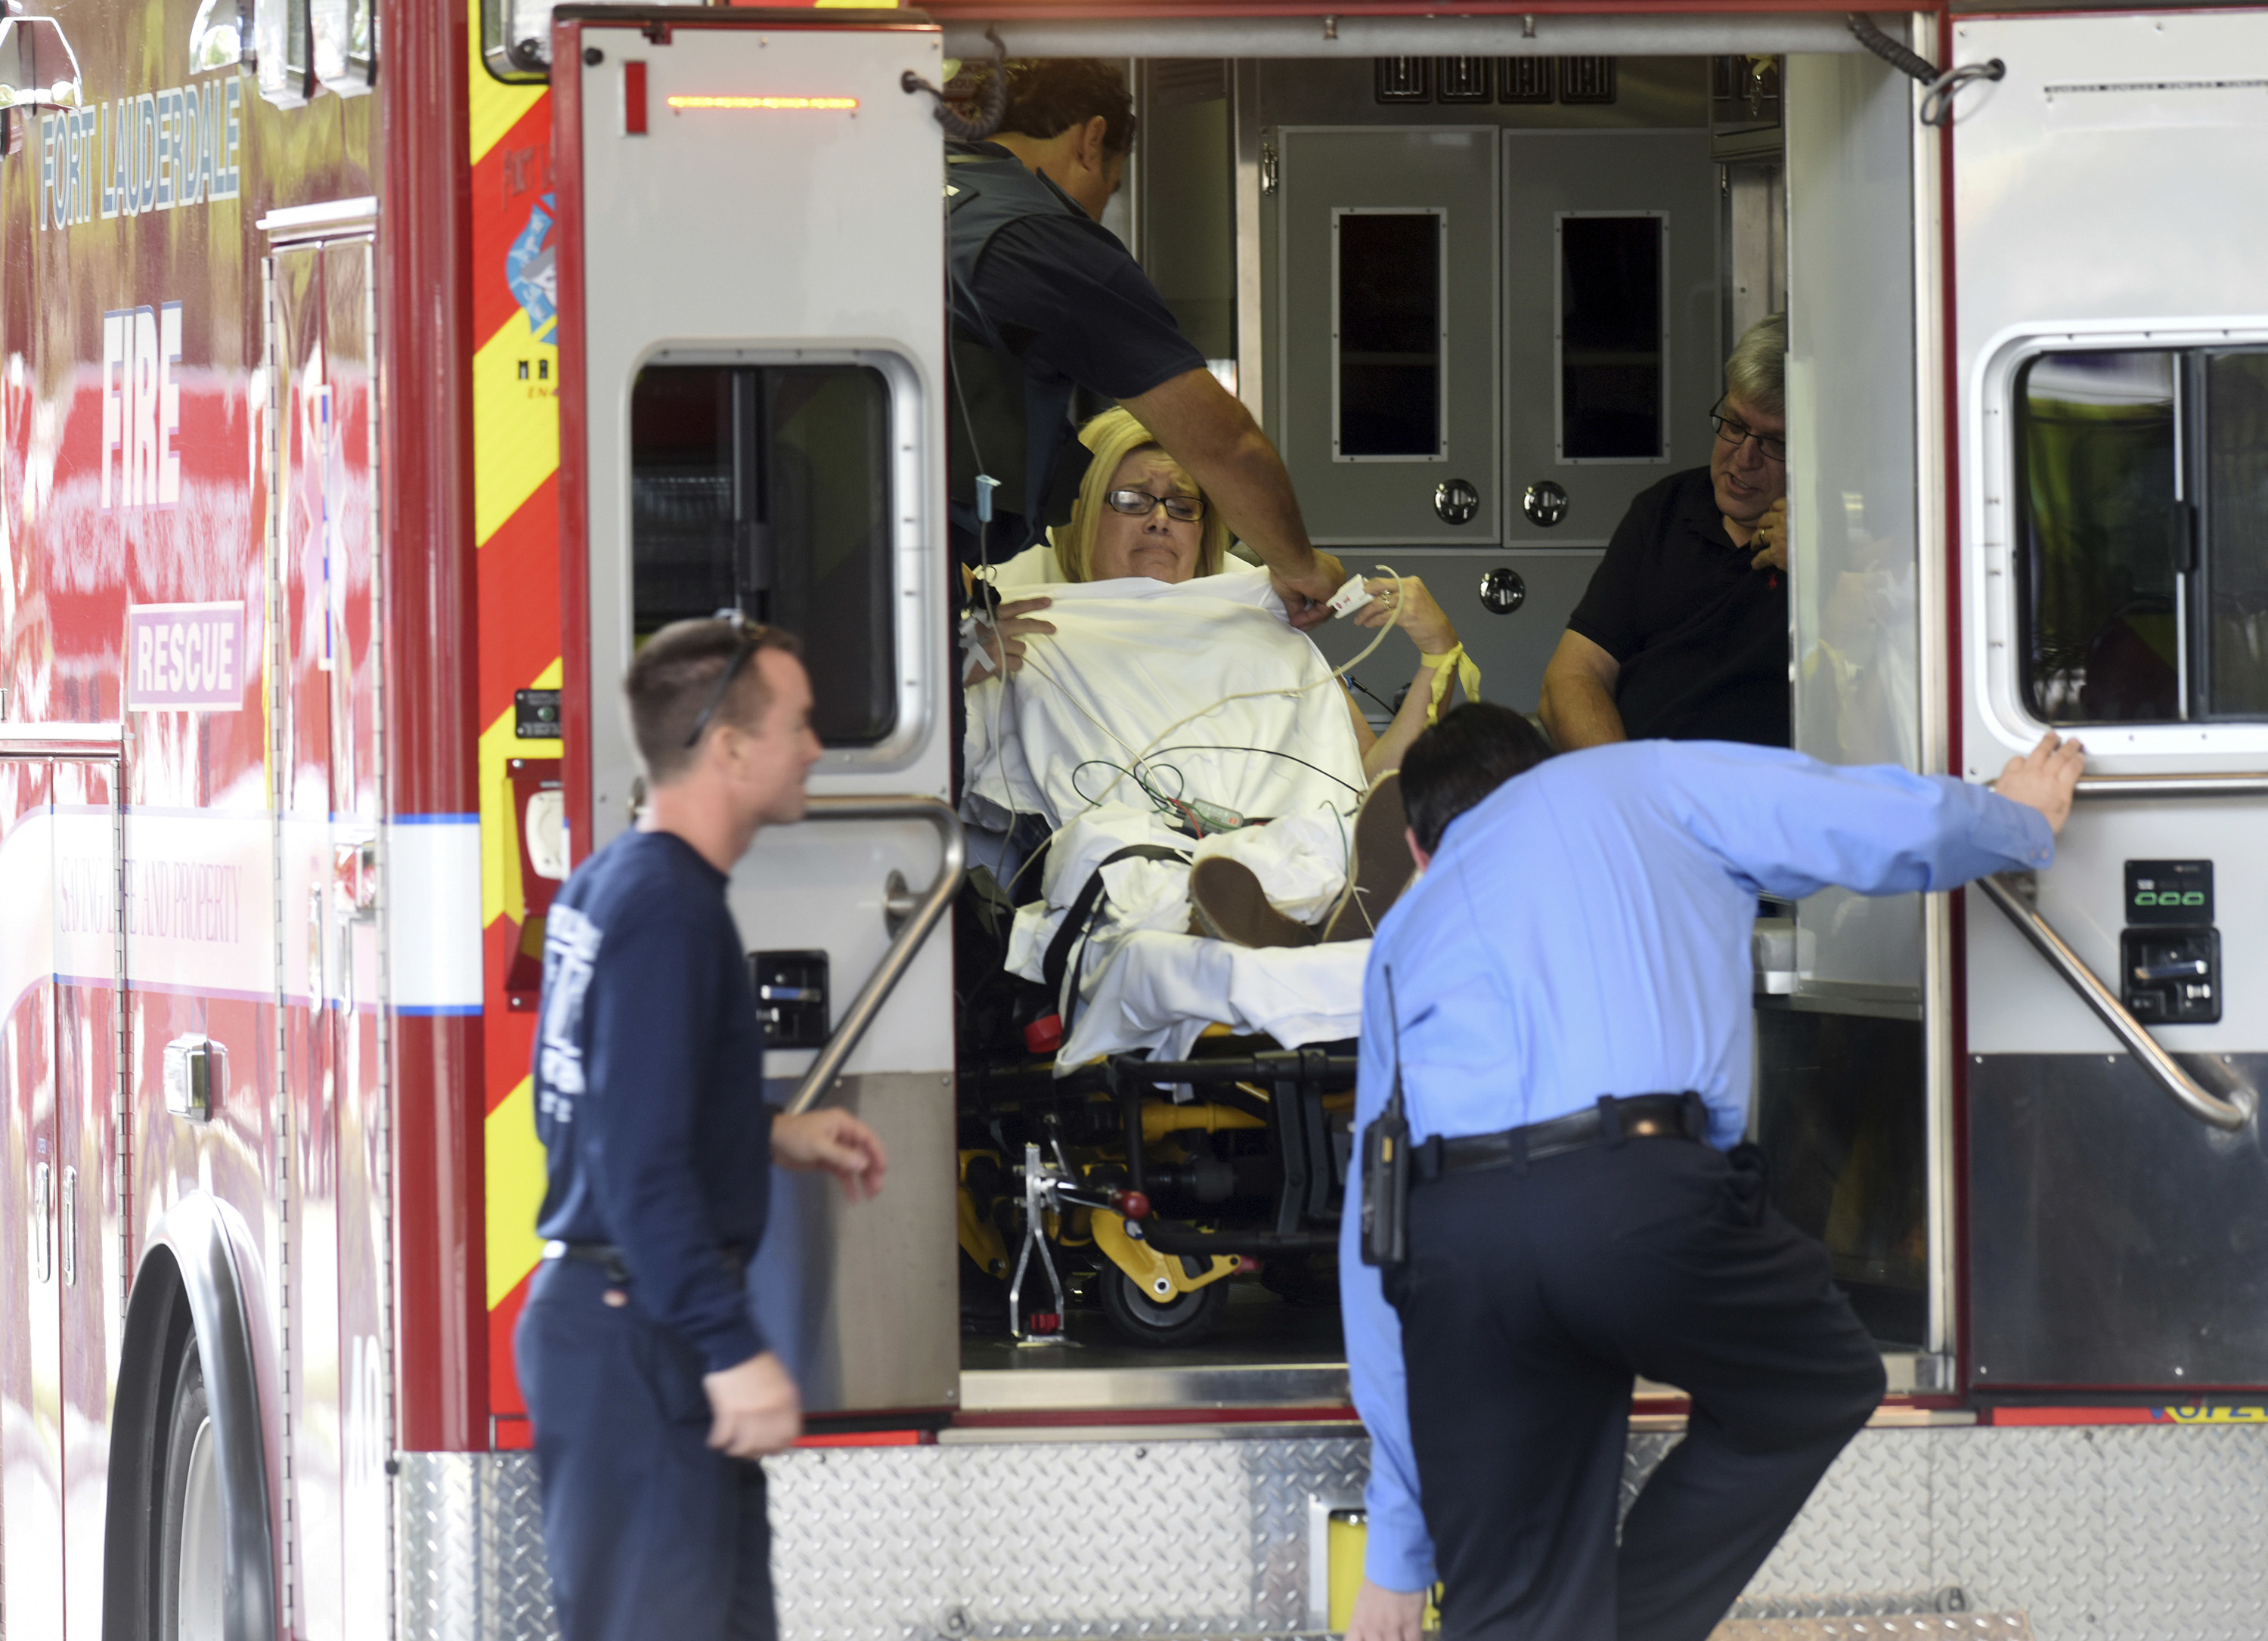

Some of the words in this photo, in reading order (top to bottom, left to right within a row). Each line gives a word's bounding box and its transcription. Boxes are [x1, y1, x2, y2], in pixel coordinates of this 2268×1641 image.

[41, 106, 96, 231] FORT
[101, 76, 240, 219] LAUDERDALE
[101, 300, 182, 514] FIRE
[137, 622, 234, 692] RESCUE
[107, 859, 137, 935] LFE
[141, 859, 169, 937] AND
[174, 862, 243, 943] PROPERTY
